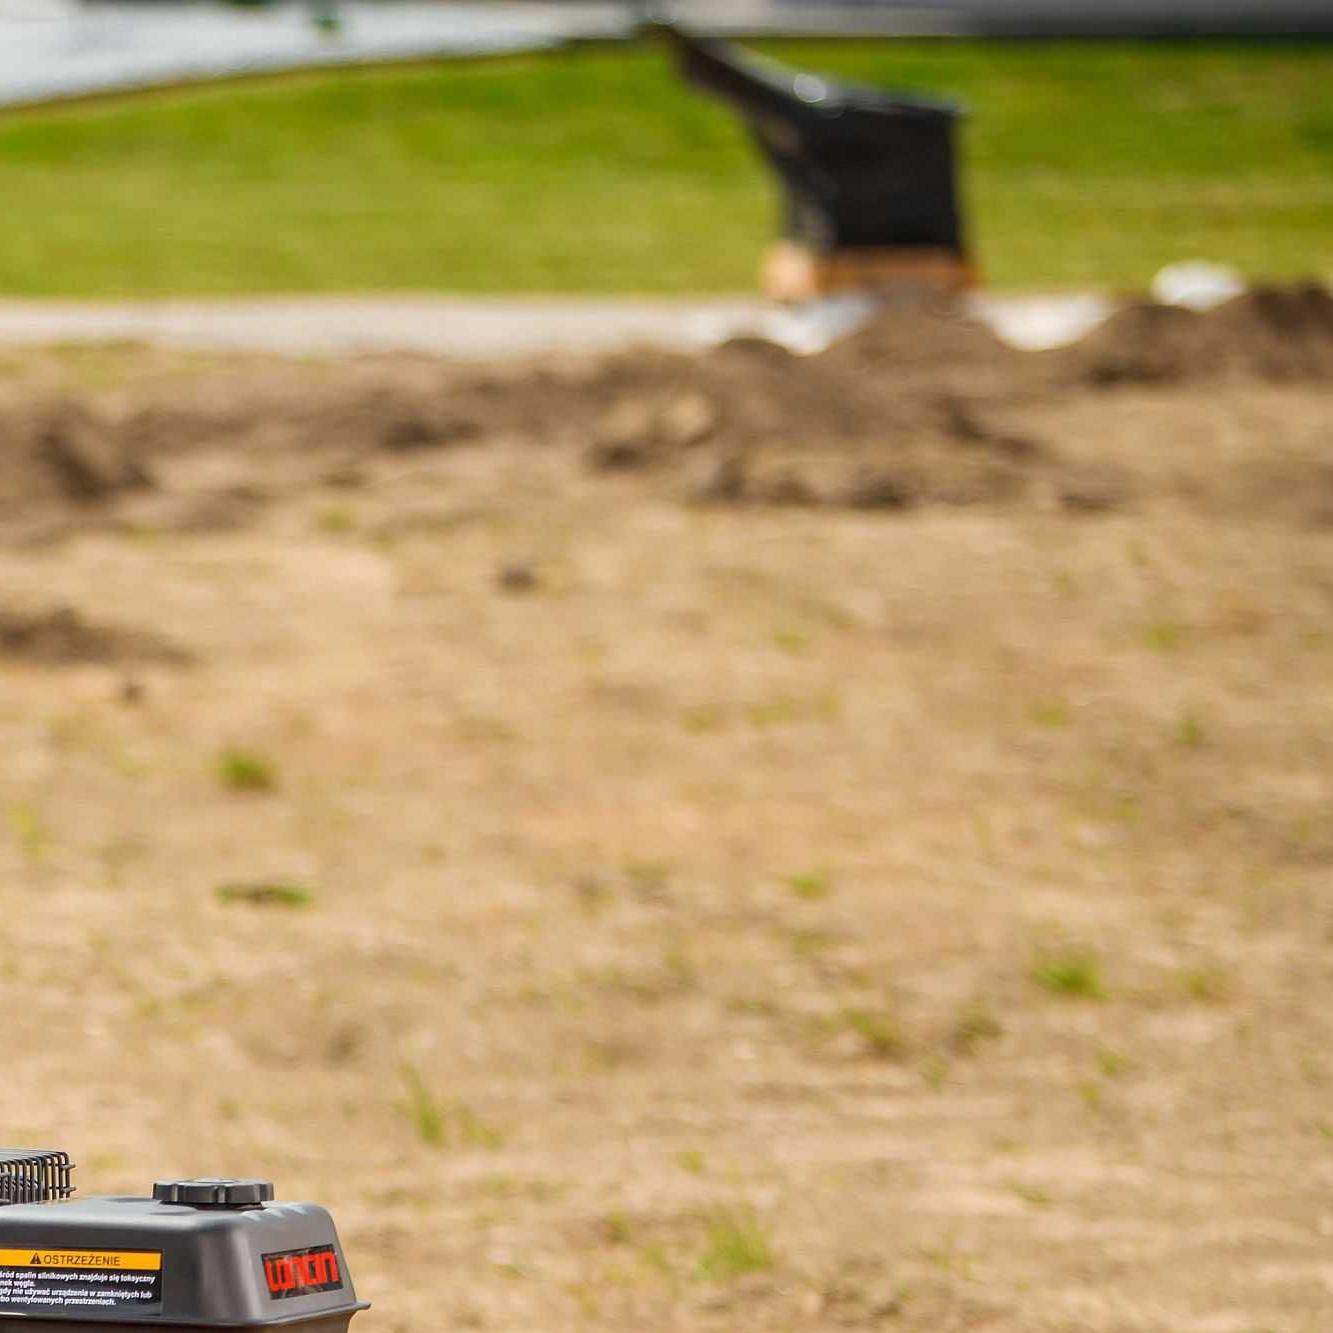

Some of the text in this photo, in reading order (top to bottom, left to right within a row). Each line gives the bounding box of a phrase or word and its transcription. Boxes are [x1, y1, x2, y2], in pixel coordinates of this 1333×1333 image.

[44, 1254, 120, 1266] OSTRZEŻENIE
[16, 1272, 36, 1280] spalin
[38, 1272, 78, 1281] silnikowych
[79, 1273, 108, 1283] znajduje
[121, 1275, 155, 1284] toksyczny
[140, 1291, 152, 1299] lub
